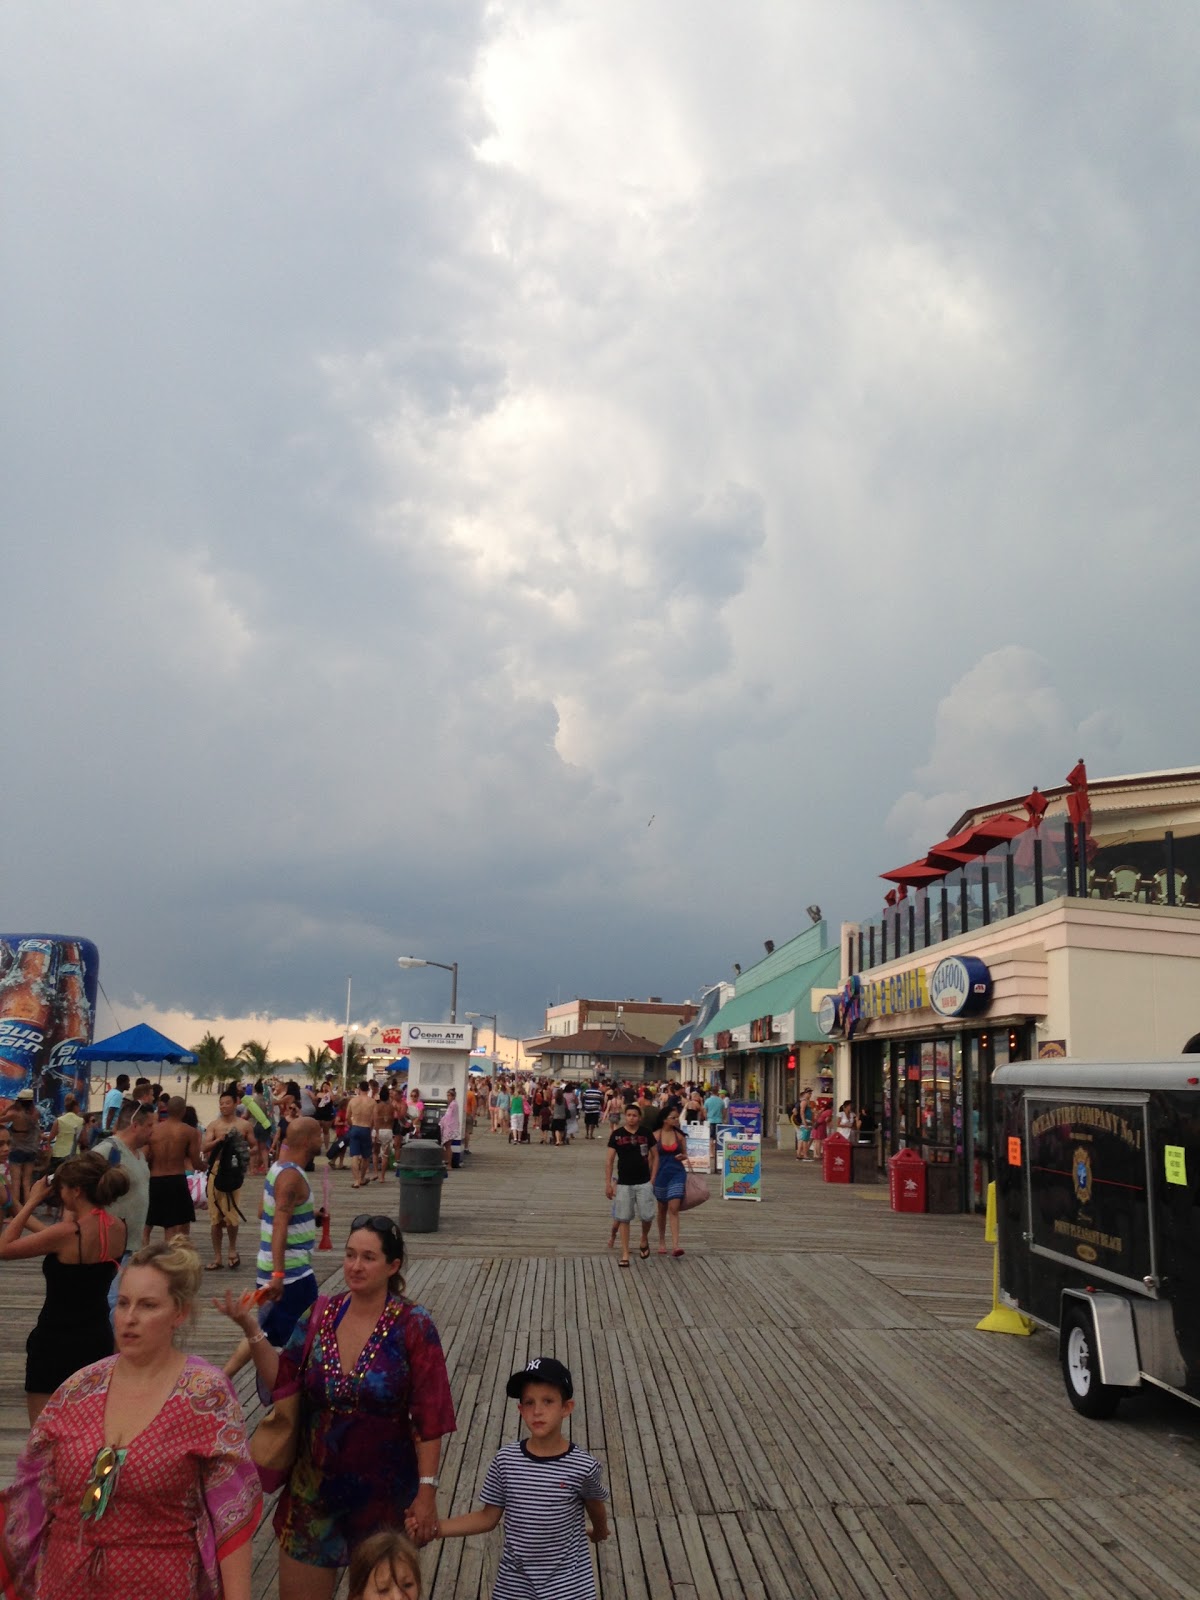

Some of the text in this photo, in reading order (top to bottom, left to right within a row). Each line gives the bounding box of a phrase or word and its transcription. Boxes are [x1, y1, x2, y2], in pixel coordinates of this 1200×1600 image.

[933, 963, 965, 1000] SEAFOOD
[0, 1024, 44, 1043] BUD
[1056, 1106, 1077, 1125] FIRE
[1077, 1106, 1120, 1135] COMPANY
[1070, 1223, 1101, 1245] PLEASANT
